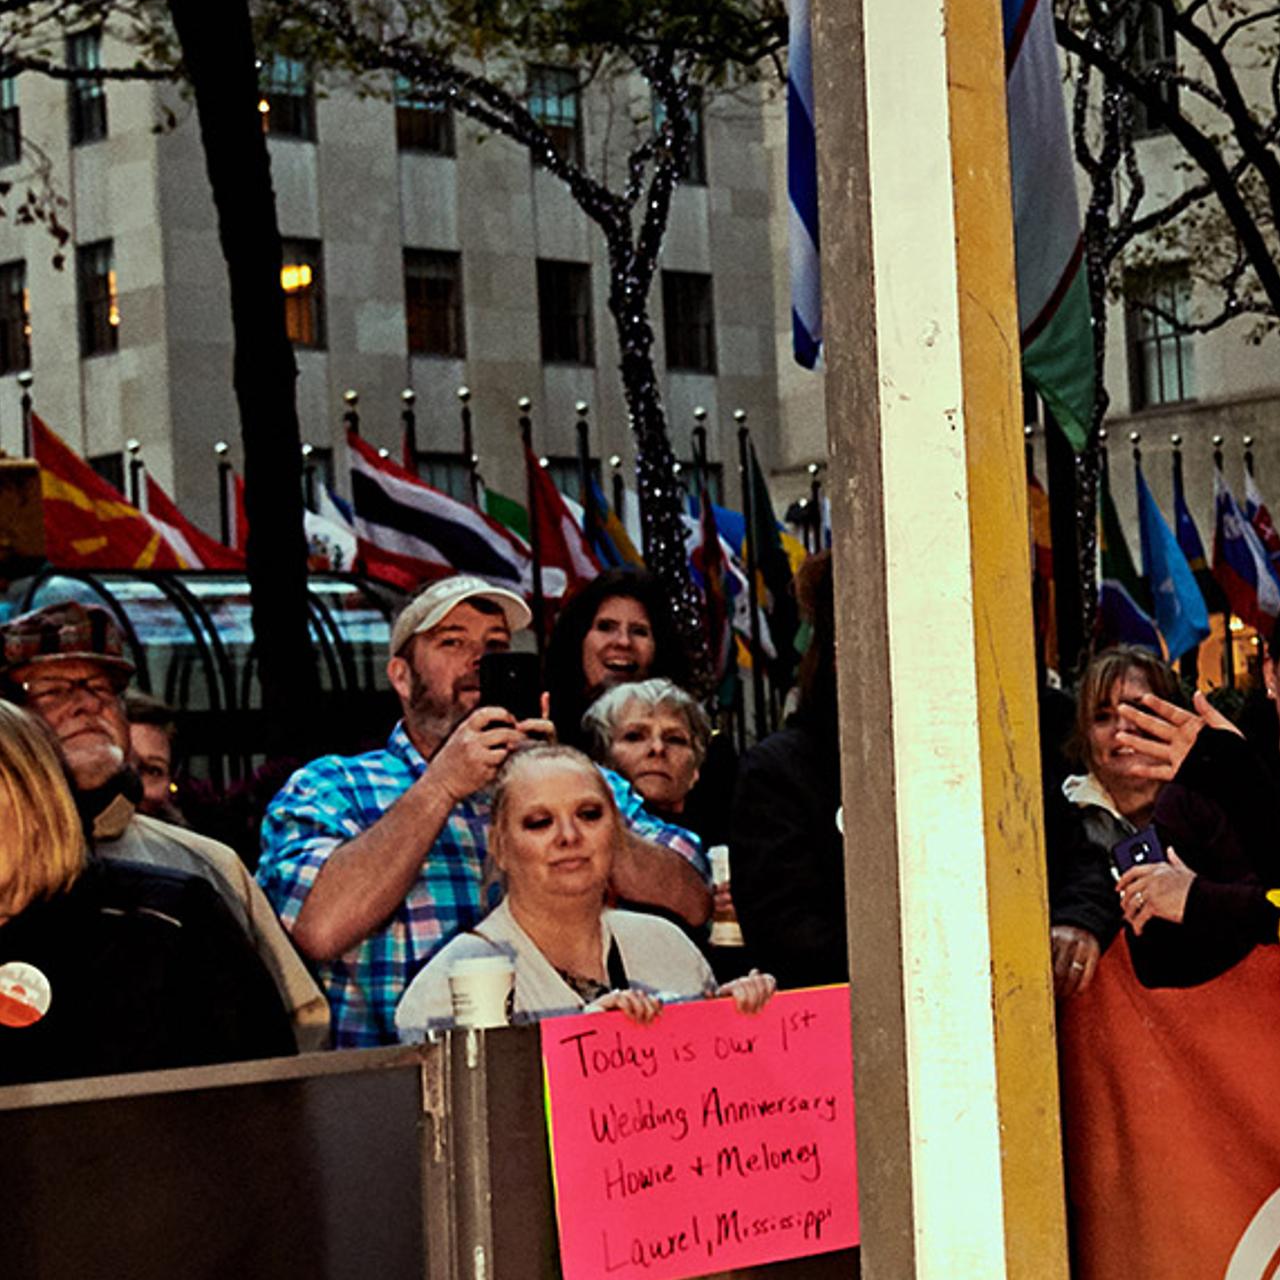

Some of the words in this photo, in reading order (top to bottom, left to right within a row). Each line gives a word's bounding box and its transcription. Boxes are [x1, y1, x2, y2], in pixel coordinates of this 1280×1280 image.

[559, 1029, 658, 1078] Today
[672, 1041, 697, 1063] is
[779, 1009, 818, 1052] 1st
[589, 1096, 690, 1145] Wedding
[701, 1086, 837, 1129] Anniversary
[604, 1158, 677, 1200] Howie
[716, 1142, 822, 1183] Meloney
[716, 1202, 833, 1246] Mississippi
